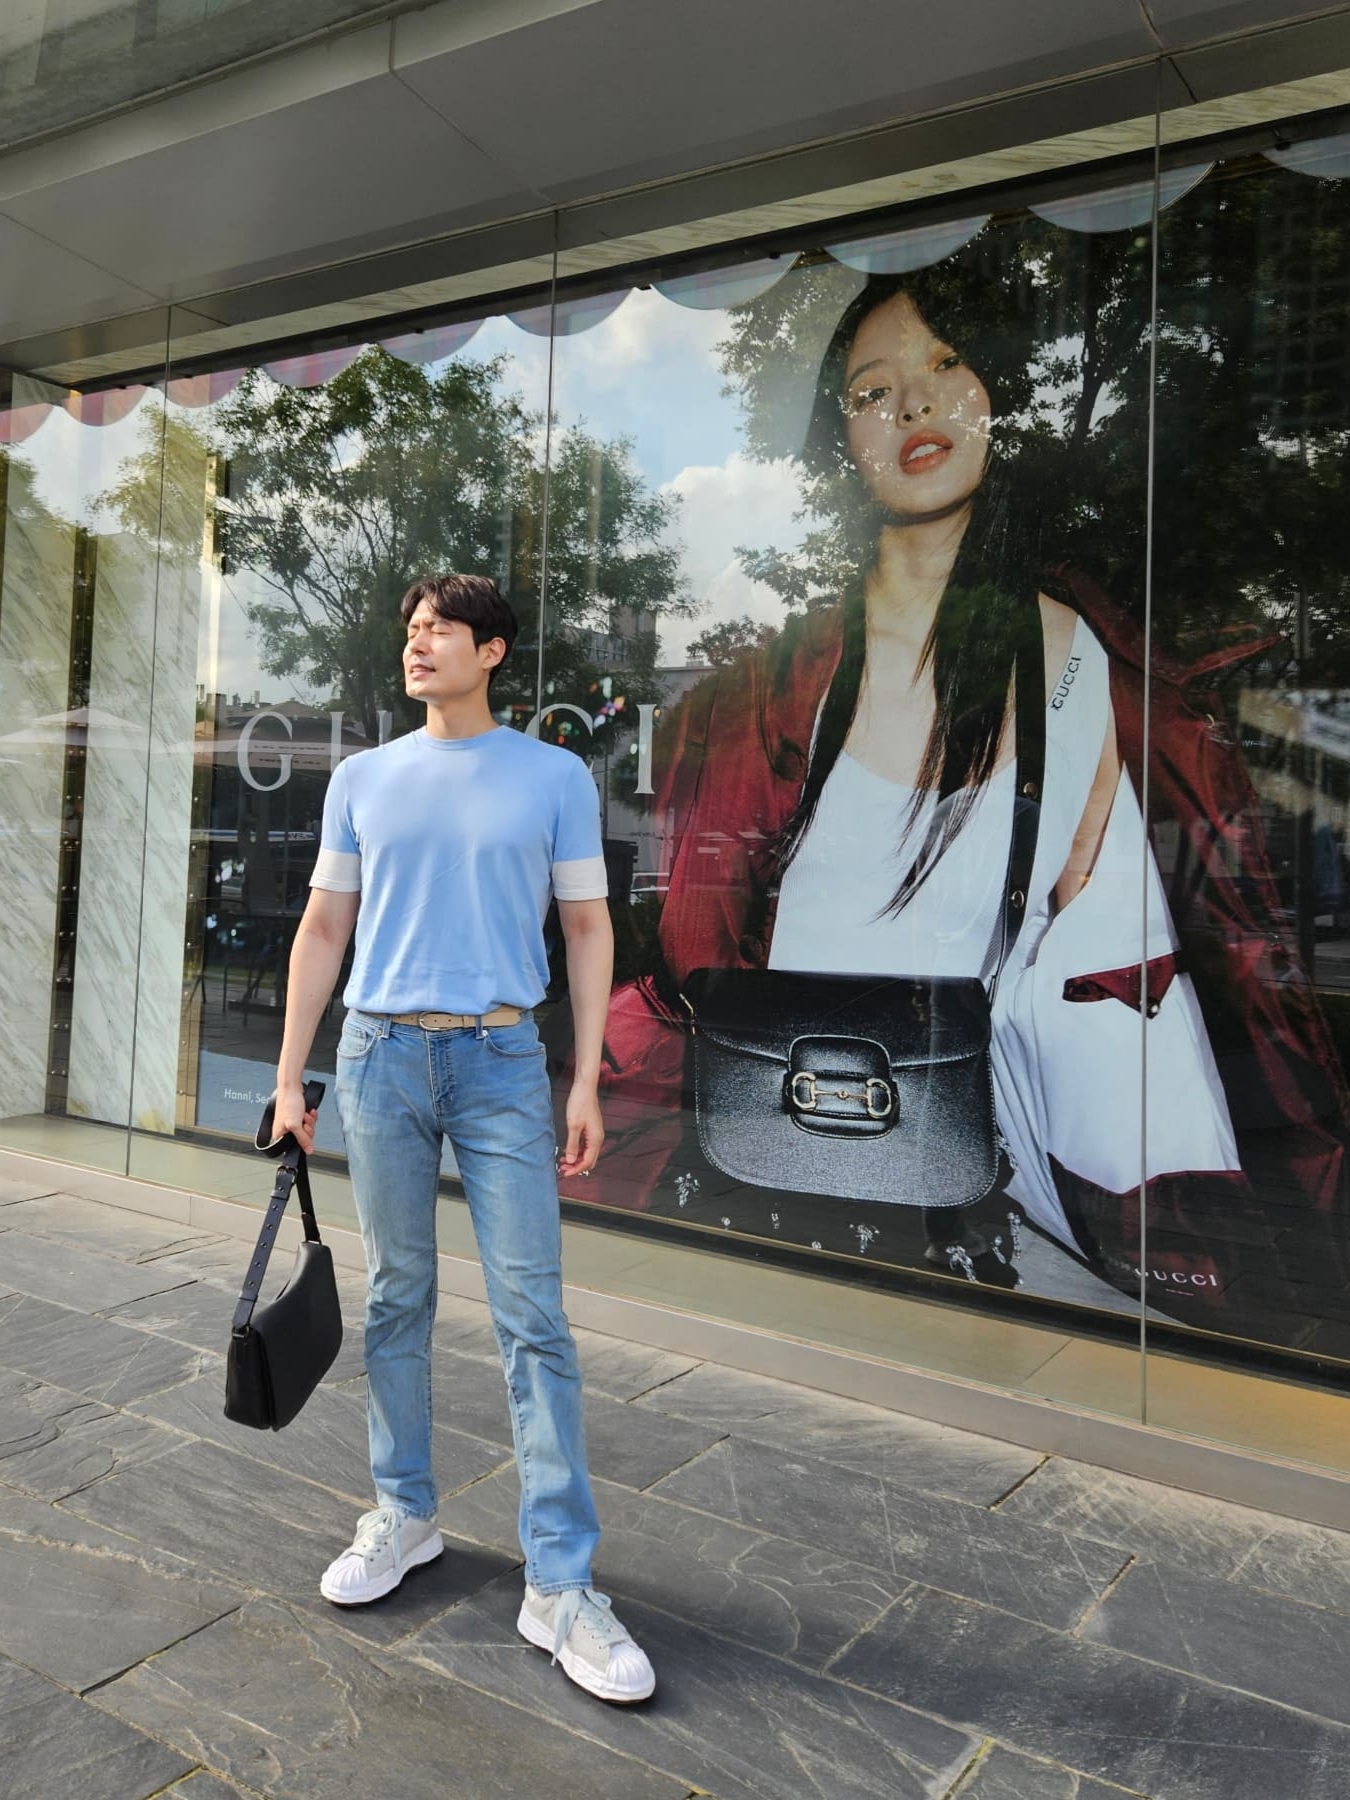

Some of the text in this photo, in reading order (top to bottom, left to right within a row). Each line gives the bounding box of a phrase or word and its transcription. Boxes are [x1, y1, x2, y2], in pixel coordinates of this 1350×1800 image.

[1051, 656, 1081, 711] GUCCI
[237, 703, 657, 794] GUI
[223, 1088, 254, 1104] Hanni,
